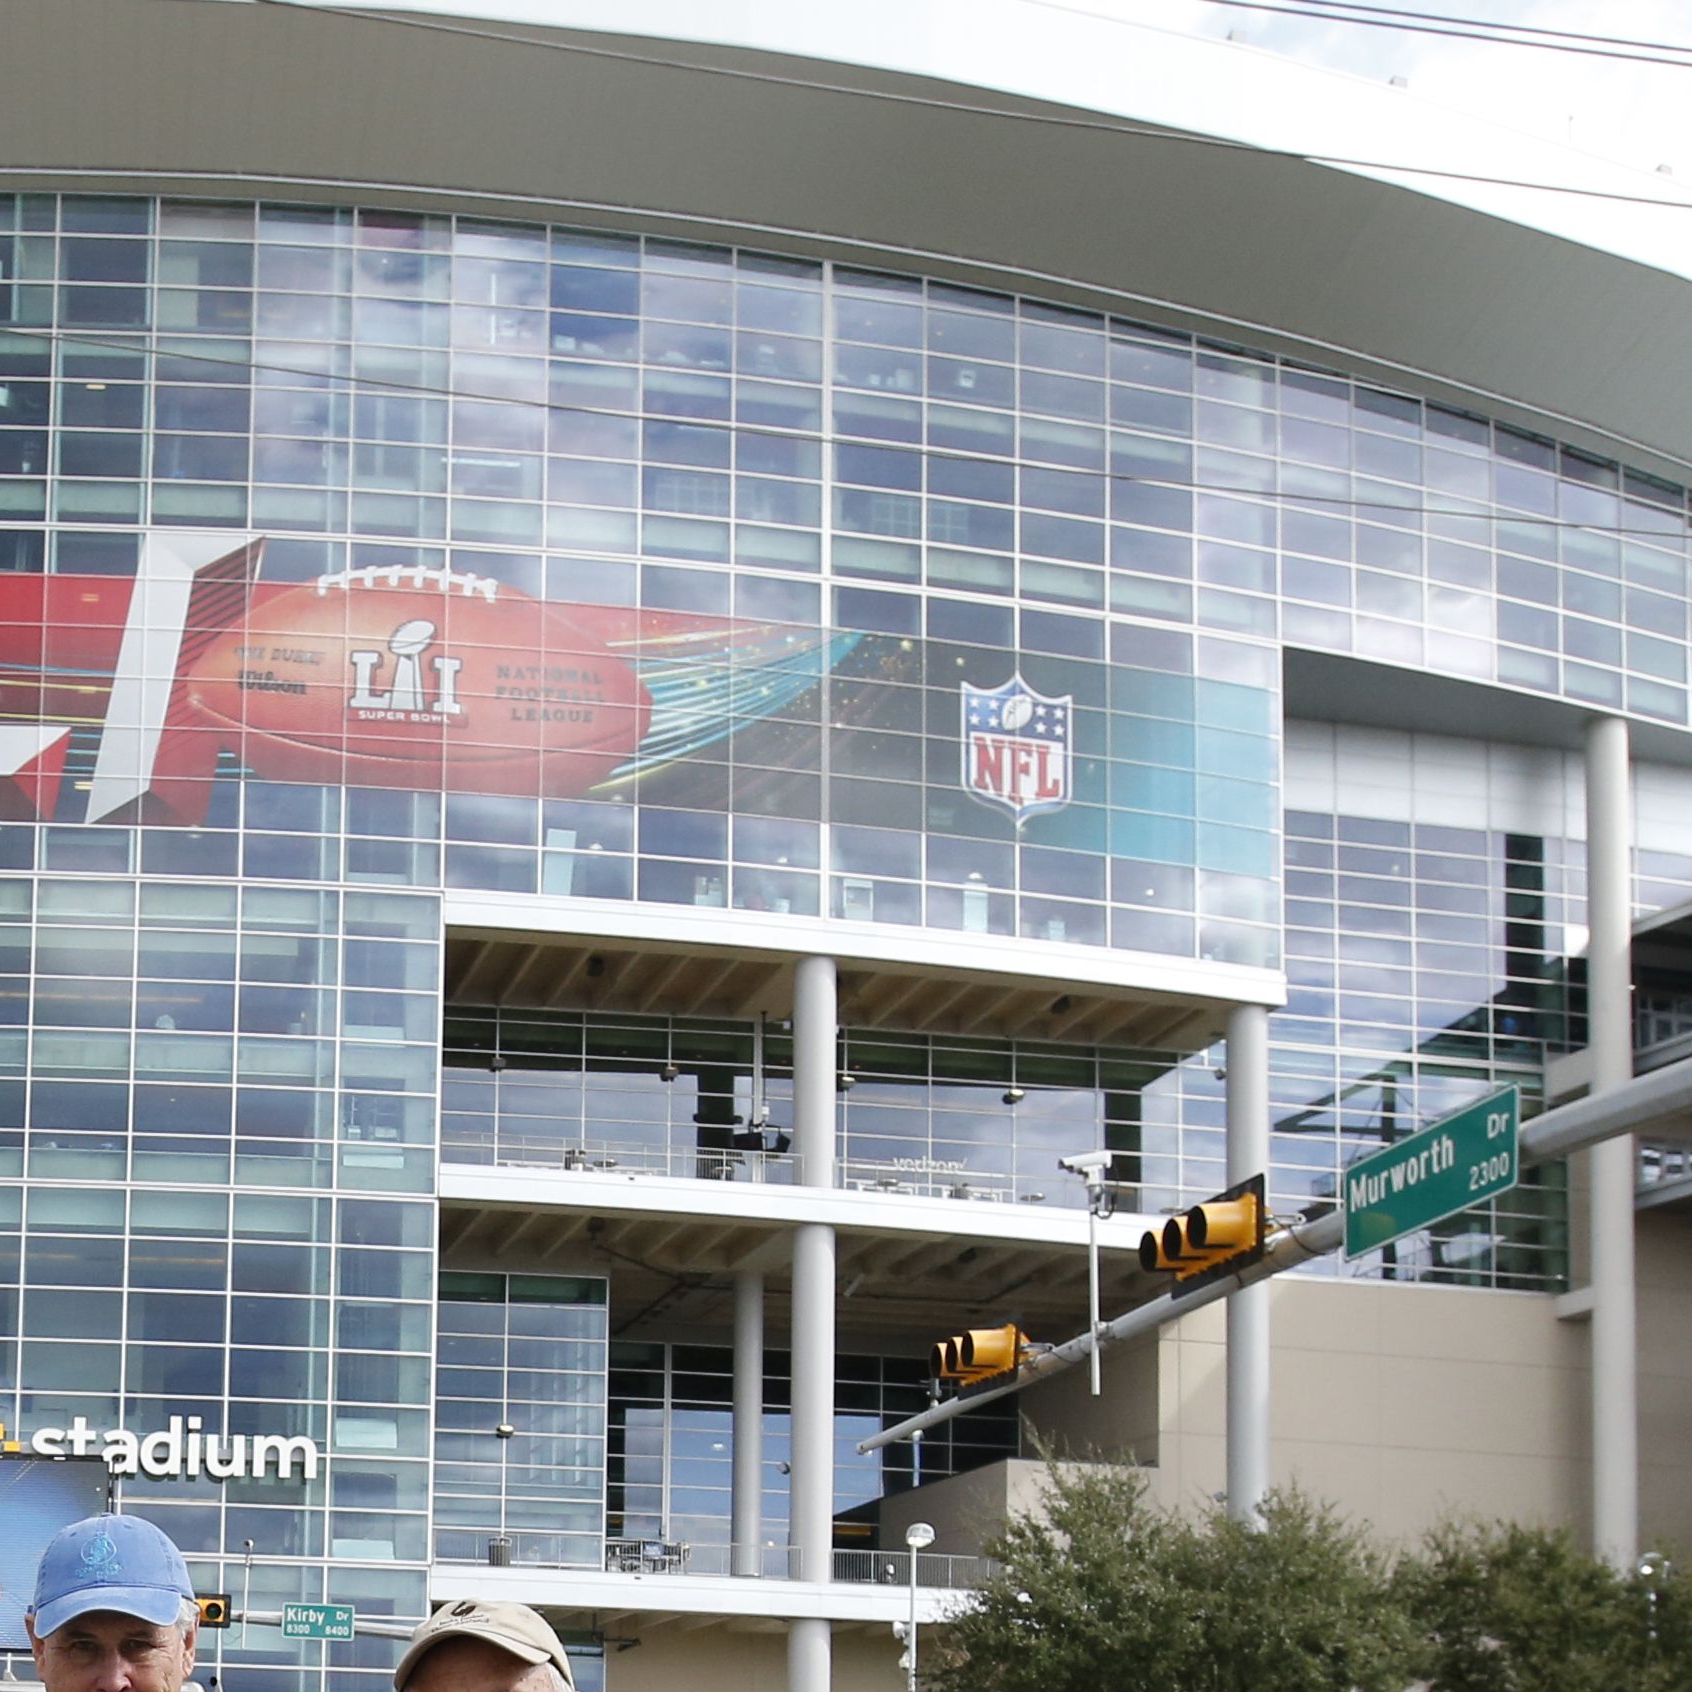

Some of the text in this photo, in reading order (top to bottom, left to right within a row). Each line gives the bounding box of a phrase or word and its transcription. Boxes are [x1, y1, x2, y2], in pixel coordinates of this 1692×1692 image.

[238, 670, 307, 695] Wilson
[496, 664, 604, 685] NATIONAL
[494, 685, 605, 705] FOOTBALL
[358, 709, 451, 725] SUPER BOWL
[510, 708, 594, 725] LEAGUE
[974, 735, 1060, 808] NFL
[892, 1155, 958, 1173] verizon
[1350, 1112, 1510, 1213] Murworth Dr
[1469, 1152, 1509, 1191] 2300
[31, 1414, 318, 1479] stadium
[287, 1607, 349, 1626] Kirby Dr
[286, 1624, 349, 1636] 8300 8400
